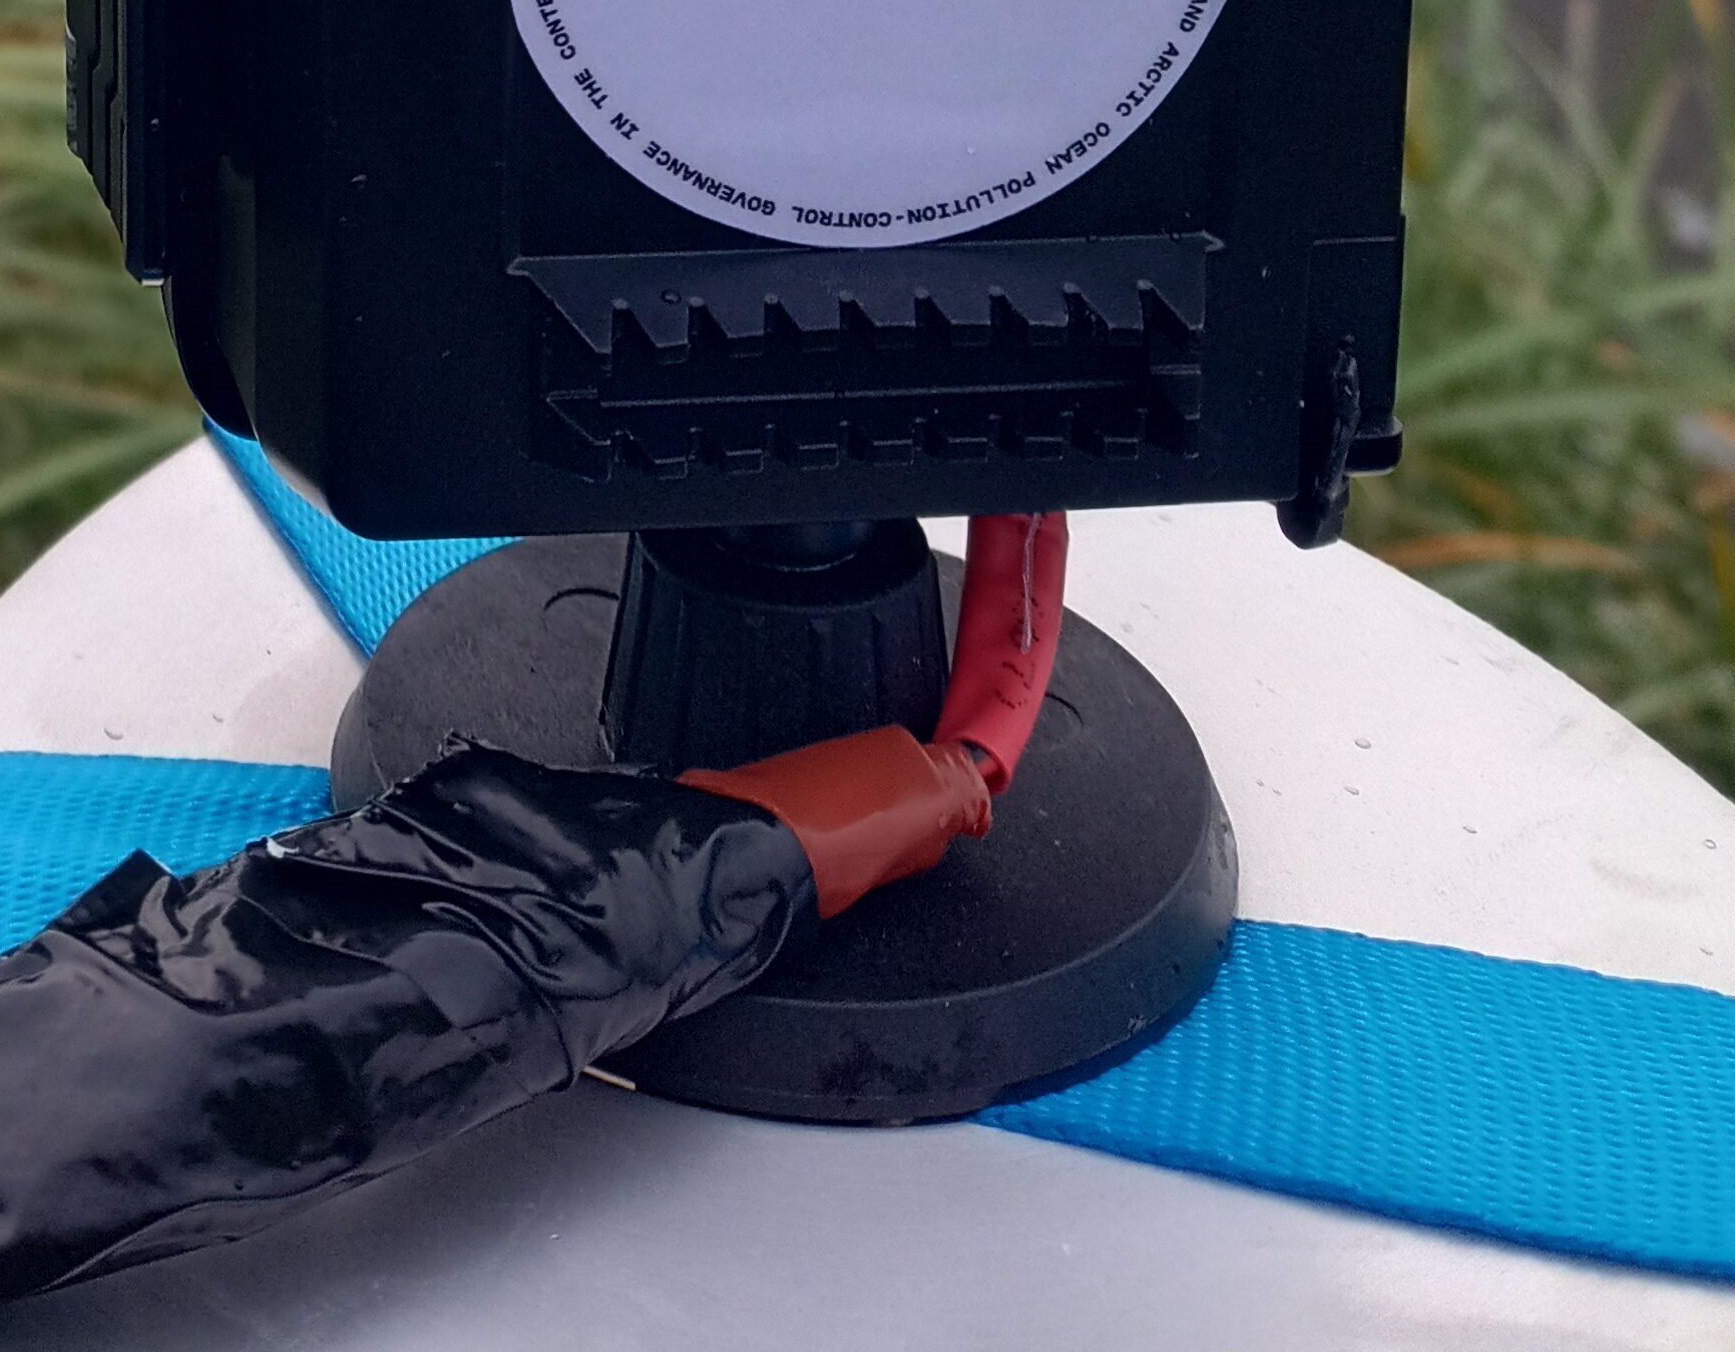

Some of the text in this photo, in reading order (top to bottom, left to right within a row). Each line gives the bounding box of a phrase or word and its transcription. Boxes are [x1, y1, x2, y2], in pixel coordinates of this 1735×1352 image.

[573, 67, 609, 111] THE
[1115, 41, 1180, 118] ARCTIC
[609, 111, 640, 141] IN
[1044, 121, 1112, 175] OCEAN
[642, 140, 777, 217] GOVERNANCE
[791, 170, 1037, 229] POLLUTION-CONTROL
